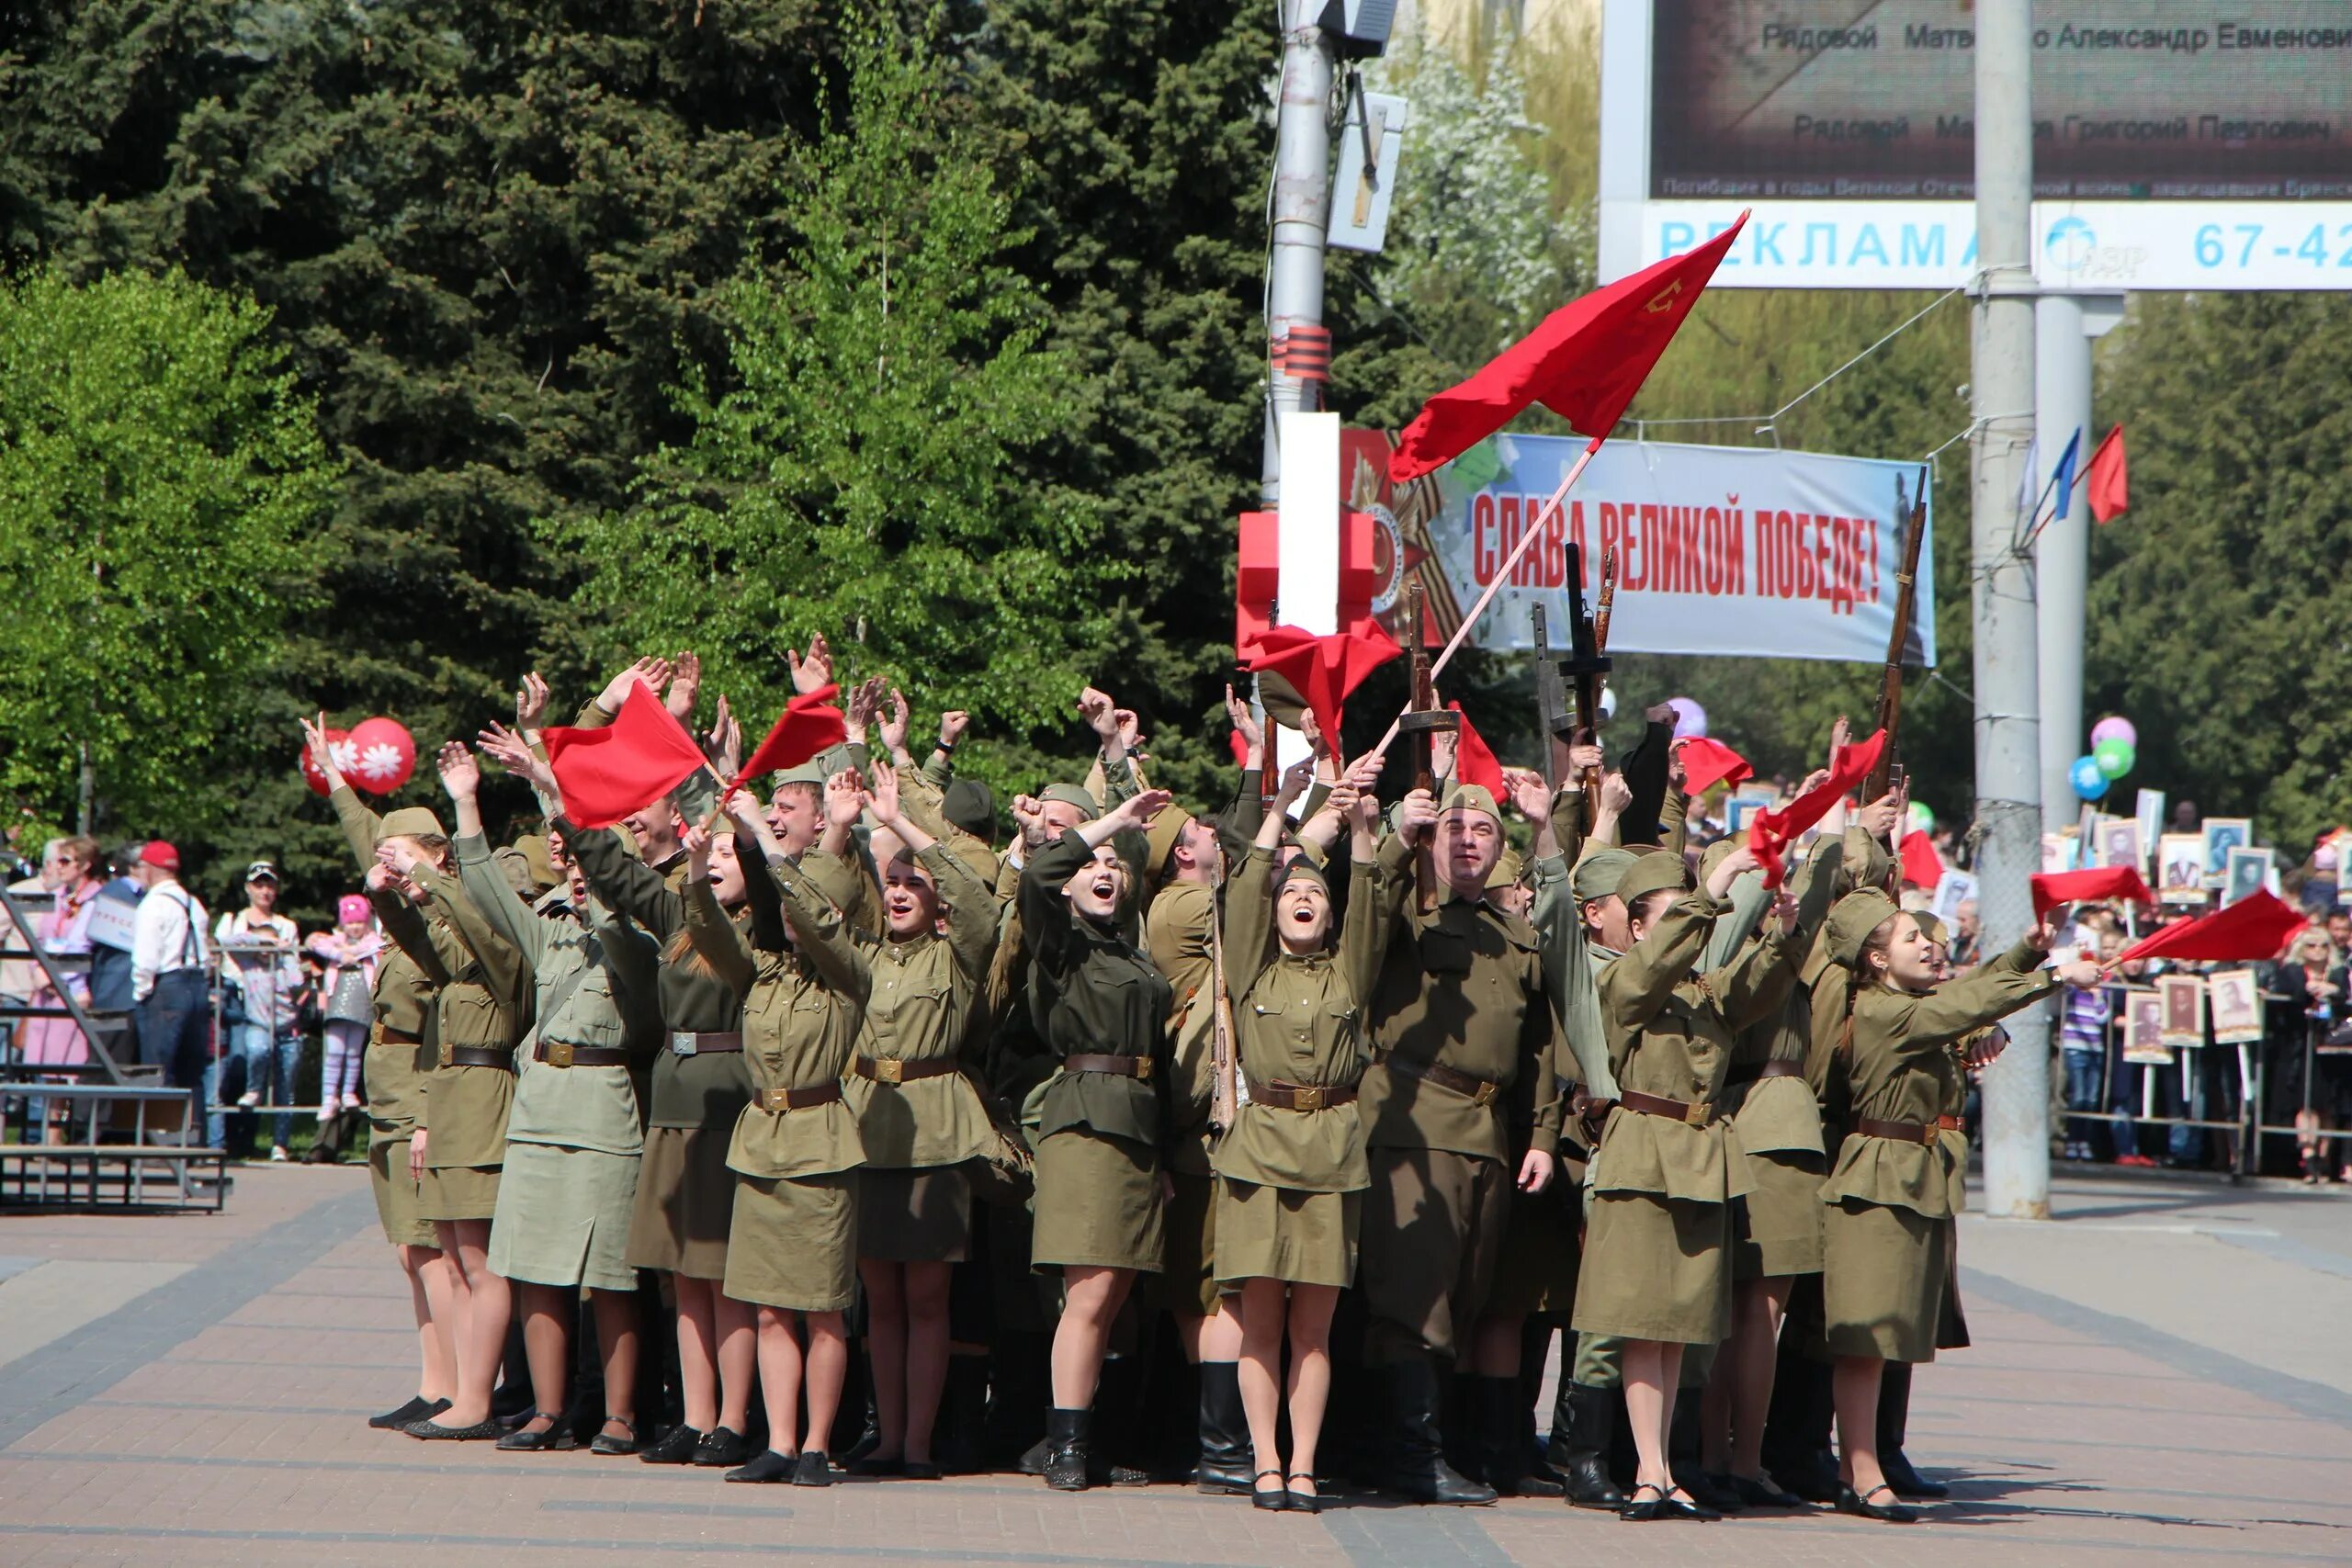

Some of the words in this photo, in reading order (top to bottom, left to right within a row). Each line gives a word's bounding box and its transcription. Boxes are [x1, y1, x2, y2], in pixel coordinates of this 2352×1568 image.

[1763, 23, 1877, 51] Рядовой
[2059, 23, 2208, 53] Александр
[1794, 114, 1908, 141] Рядовой
[2064, 115, 2188, 143] Григорий
[2199, 115, 2329, 140] Павлович
[1474, 494, 1588, 589] СЛАВА
[1600, 492, 1744, 596] ВЕЛИКОЙ
[1756, 510, 1879, 615] ПОБЕДЕ!
